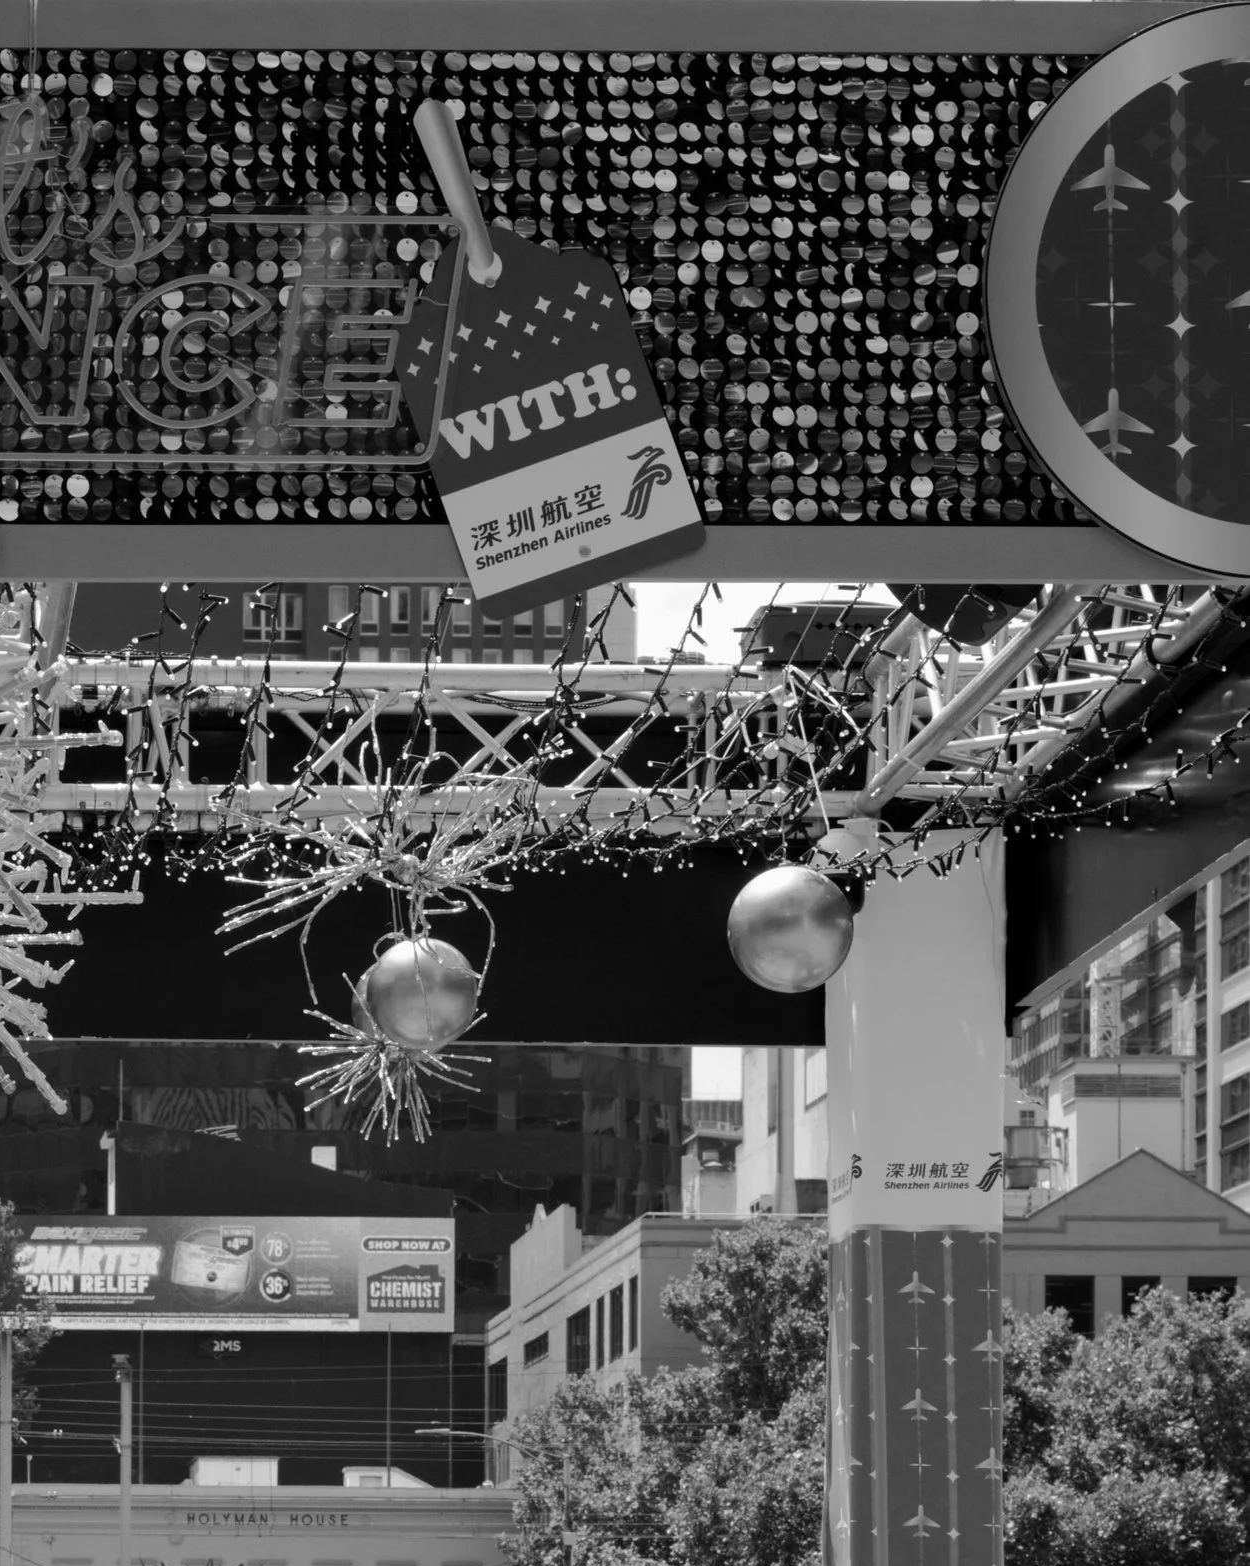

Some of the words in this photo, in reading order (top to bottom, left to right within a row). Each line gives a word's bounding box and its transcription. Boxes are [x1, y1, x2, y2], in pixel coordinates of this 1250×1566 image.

[438, 363, 637, 460] WITH:
[470, 484, 606, 551] 深圳航空
[476, 535, 549, 571] Shenzhen
[553, 514, 612, 543] Airlines
[885, 1162, 970, 1178] 深圳航空
[884, 1181, 930, 1190] Shenzhen
[933, 1181, 970, 1190] Airlines
[367, 1240, 400, 1250] SHOP
[401, 1240, 430, 1250] NOW
[431, 1240, 447, 1250] AT
[25, 1274, 74, 1293] PAIN
[80, 1274, 150, 1293] RELIEF
[370, 1281, 443, 1298] CHEMIST
[370, 1299, 440, 1309] WAREHOUSE
[186, 1512, 269, 1526] HOLYMAN
[289, 1513, 349, 1526] HOUSE
